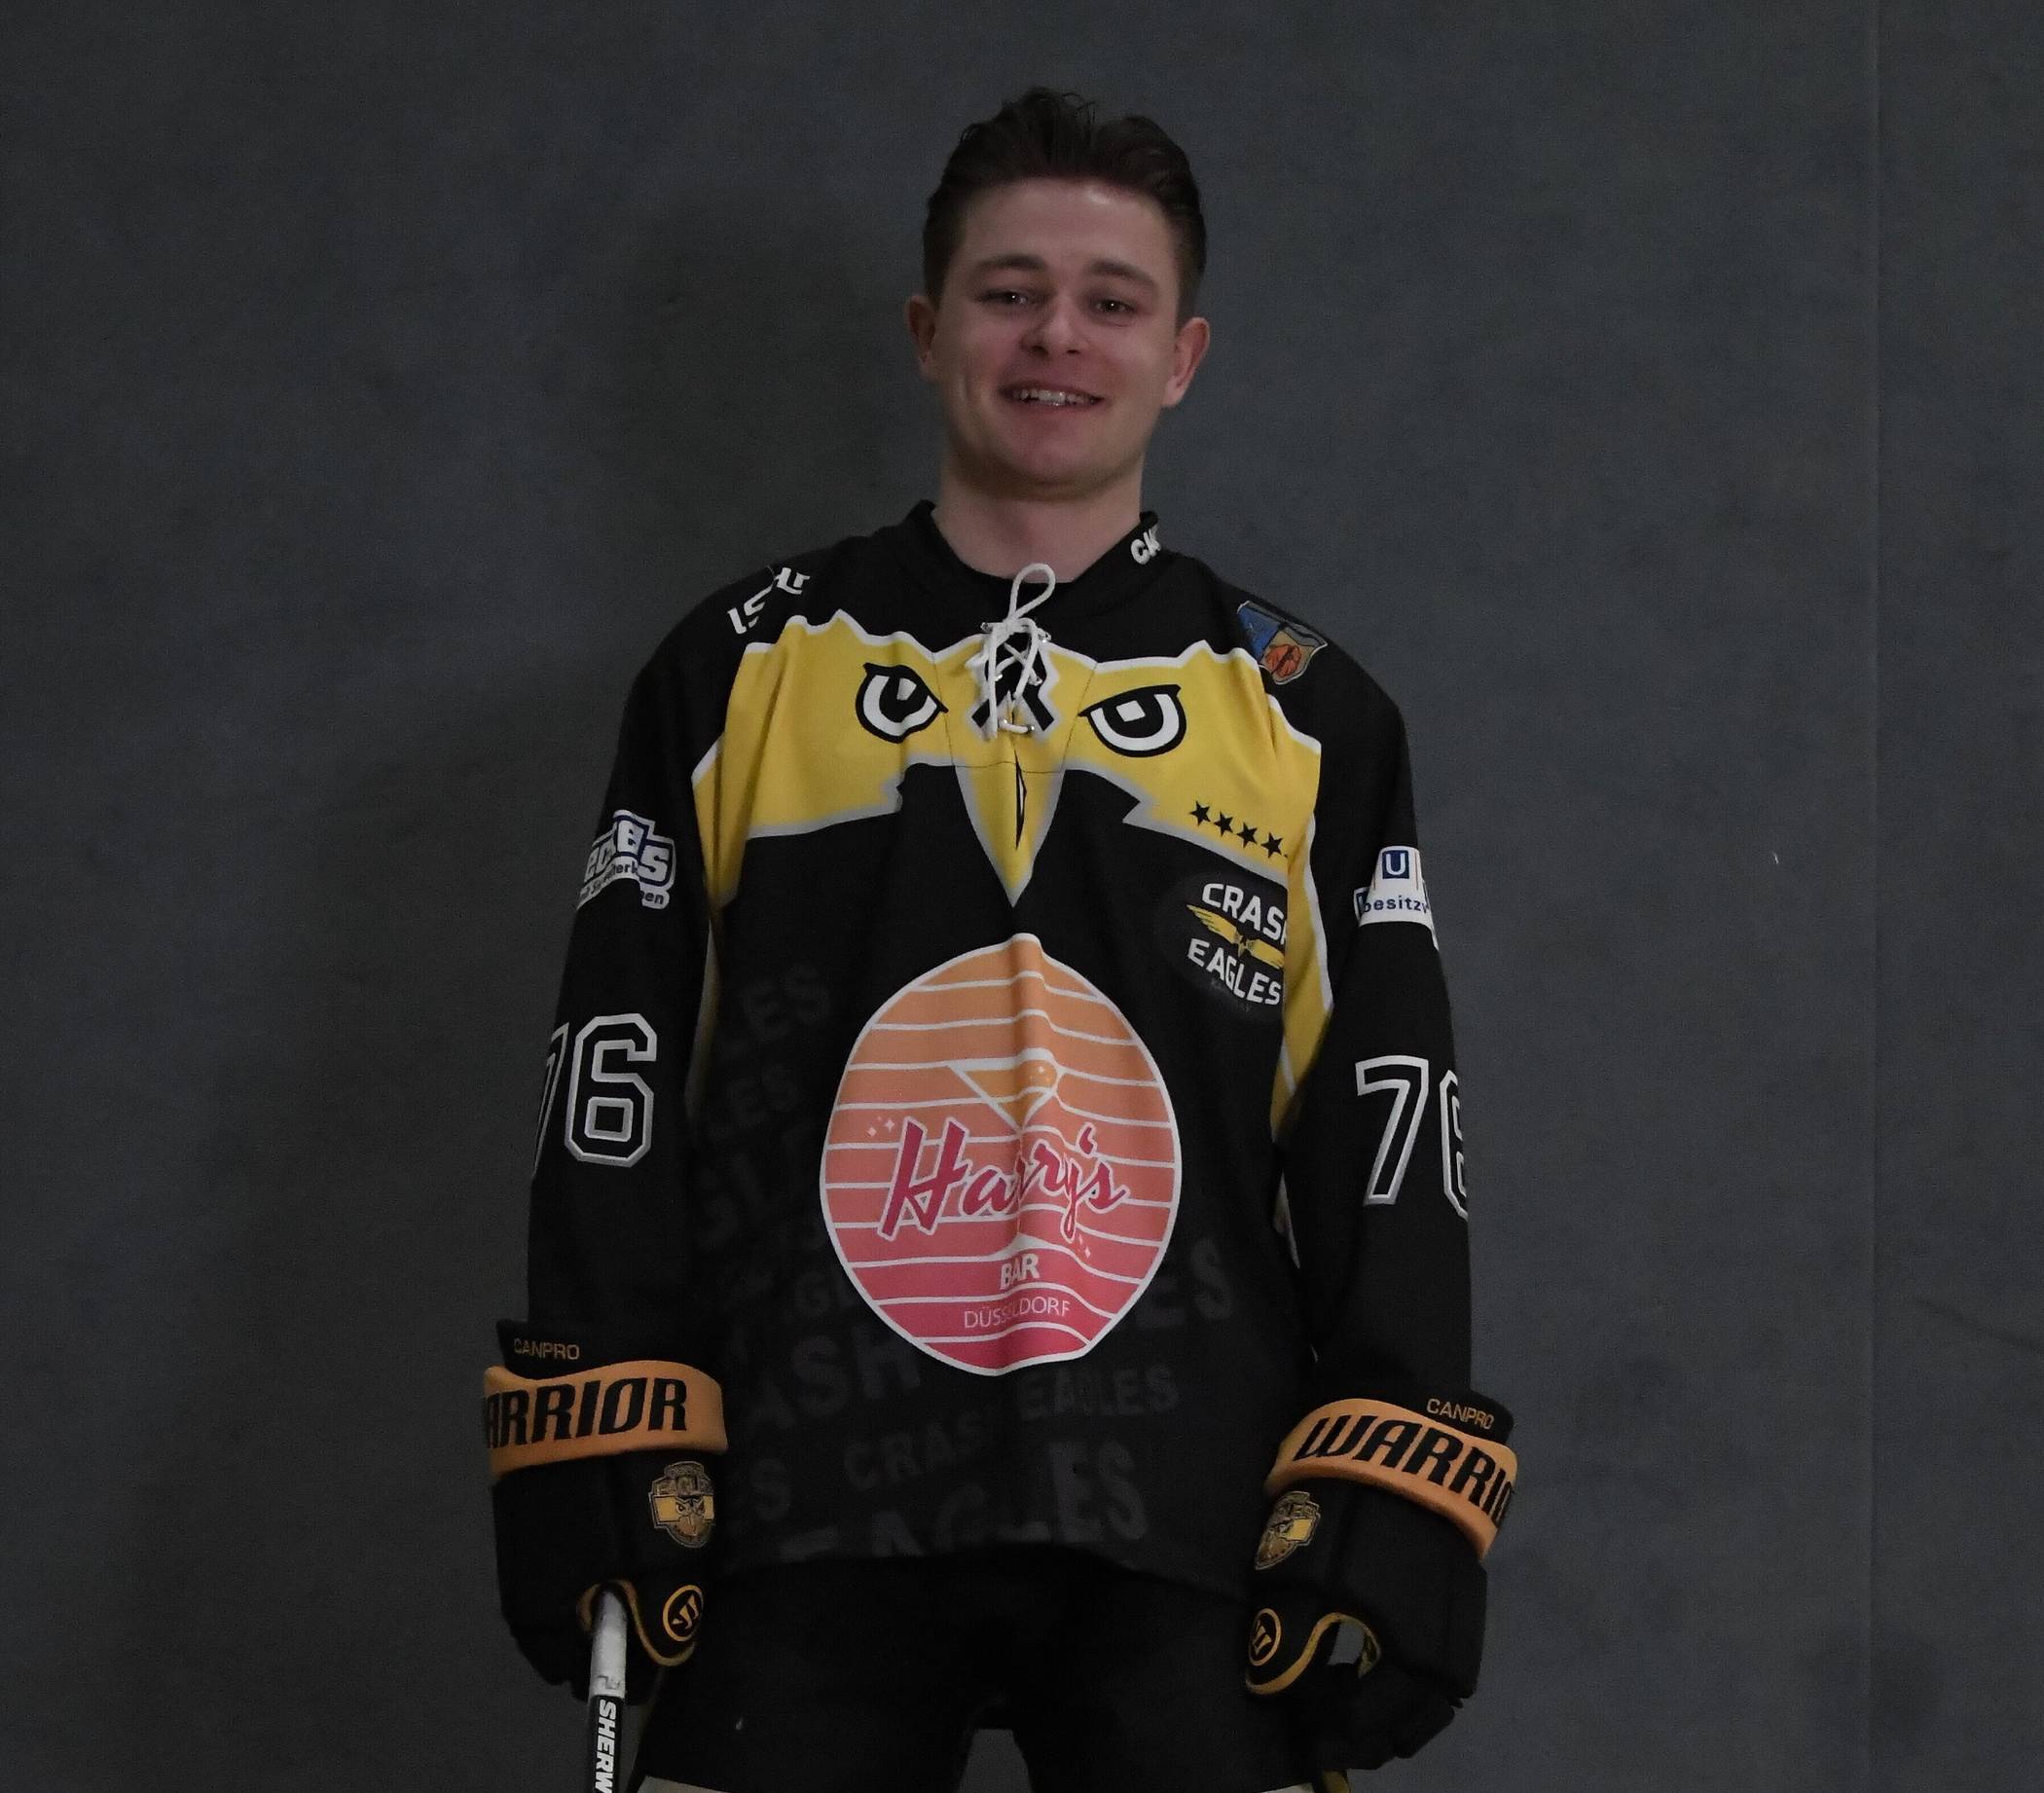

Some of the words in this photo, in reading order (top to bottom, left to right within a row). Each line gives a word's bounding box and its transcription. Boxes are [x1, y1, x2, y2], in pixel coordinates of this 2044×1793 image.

[1385, 853, 1406, 876] U
[1201, 882, 1287, 945] CRAS
[1186, 937, 1282, 1006] EAGLES
[1000, 1253, 1040, 1290] BAR
[964, 1296, 1071, 1329] DÜSSLDORF
[513, 1337, 581, 1360] CANPRO
[1426, 1398, 1495, 1430] CANPRO
